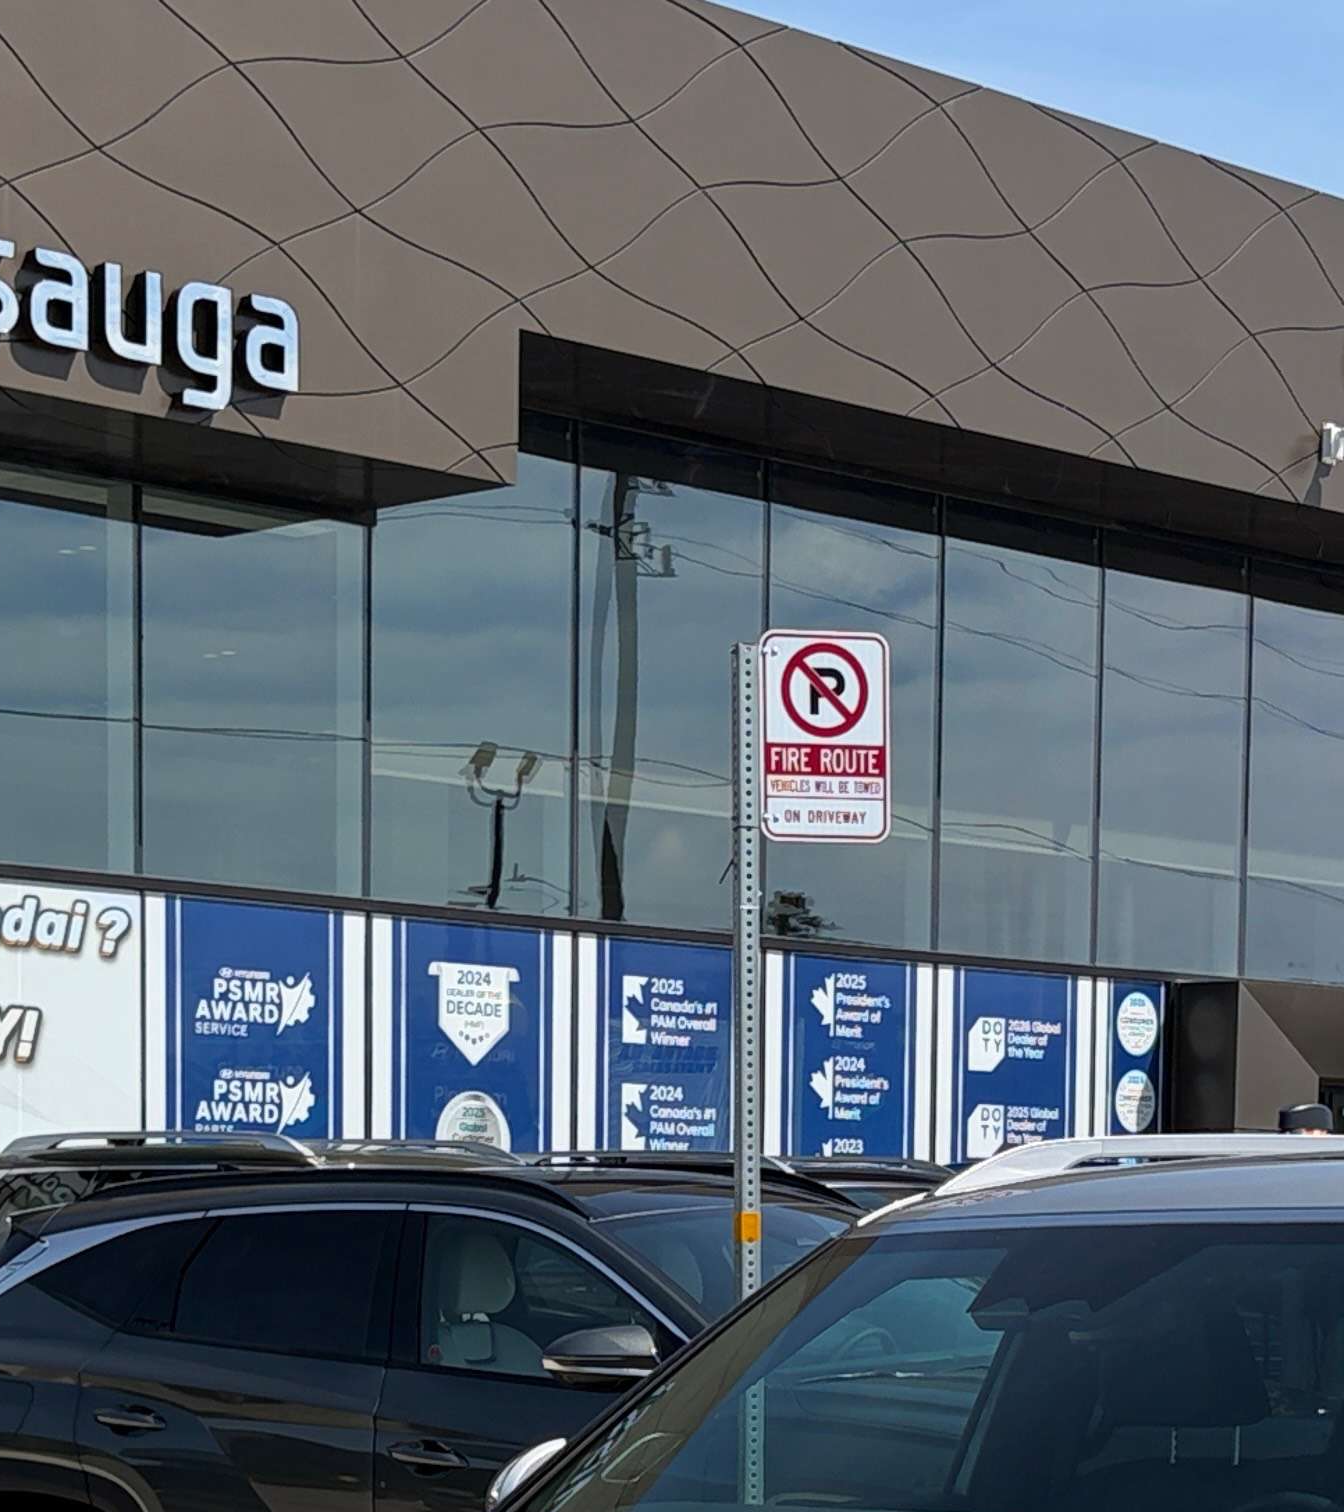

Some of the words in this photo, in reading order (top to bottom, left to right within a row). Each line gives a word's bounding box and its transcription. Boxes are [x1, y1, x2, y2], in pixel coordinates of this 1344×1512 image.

[770, 746, 812, 773] FIRE
[819, 748, 881, 775] ROUTE
[770, 779, 811, 793] VEHICLES
[814, 780, 835, 794] WILL
[838, 780, 850, 794] BE
[854, 780, 881, 795] TOWED
[784, 809, 801, 823] ON
[808, 810, 867, 825] DRIVEWAY
[95, 906, 131, 957] ?
[457, 970, 492, 986] 2024
[836, 973, 867, 991] 2025
[213, 977, 280, 1003] PSMR
[650, 978, 685, 996] 2025
[446, 999, 503, 1018] DECADE
[650, 997, 703, 1015] Canada's
[704, 1002, 718, 1016] #1
[836, 992, 891, 1009] President's
[195, 998, 280, 1024] AWARD
[836, 1008, 869, 1023] Award
[870, 1010, 882, 1024] of
[195, 1021, 248, 1037] SERVICE
[650, 1014, 676, 1029] PAM
[677, 1016, 717, 1032] Overall
[836, 1024, 863, 1038] Merit
[1032, 1021, 1061, 1035] Global
[650, 1031, 691, 1047] Winner
[1007, 1045, 1023, 1058] the
[1023, 1046, 1045, 1060] Year
[835, 1055, 866, 1073] 2024
[213, 1079, 280, 1103] PSMR
[834, 1074, 890, 1091] President's
[649, 1085, 684, 1102] 2024
[834, 1091, 868, 1105] Award
[868, 1092, 881, 1106] of
[195, 1100, 280, 1124] AWARD
[649, 1105, 702, 1121] Canada's
[703, 1107, 717, 1121] #1
[1006, 1106, 1029, 1119] 2025
[1030, 1107, 1059, 1120] Global
[649, 1121, 675, 1136] PAM
[676, 1122, 715, 1138] Overall
[649, 1138, 690, 1151] Winner
[833, 1138, 864, 1159] 2023
